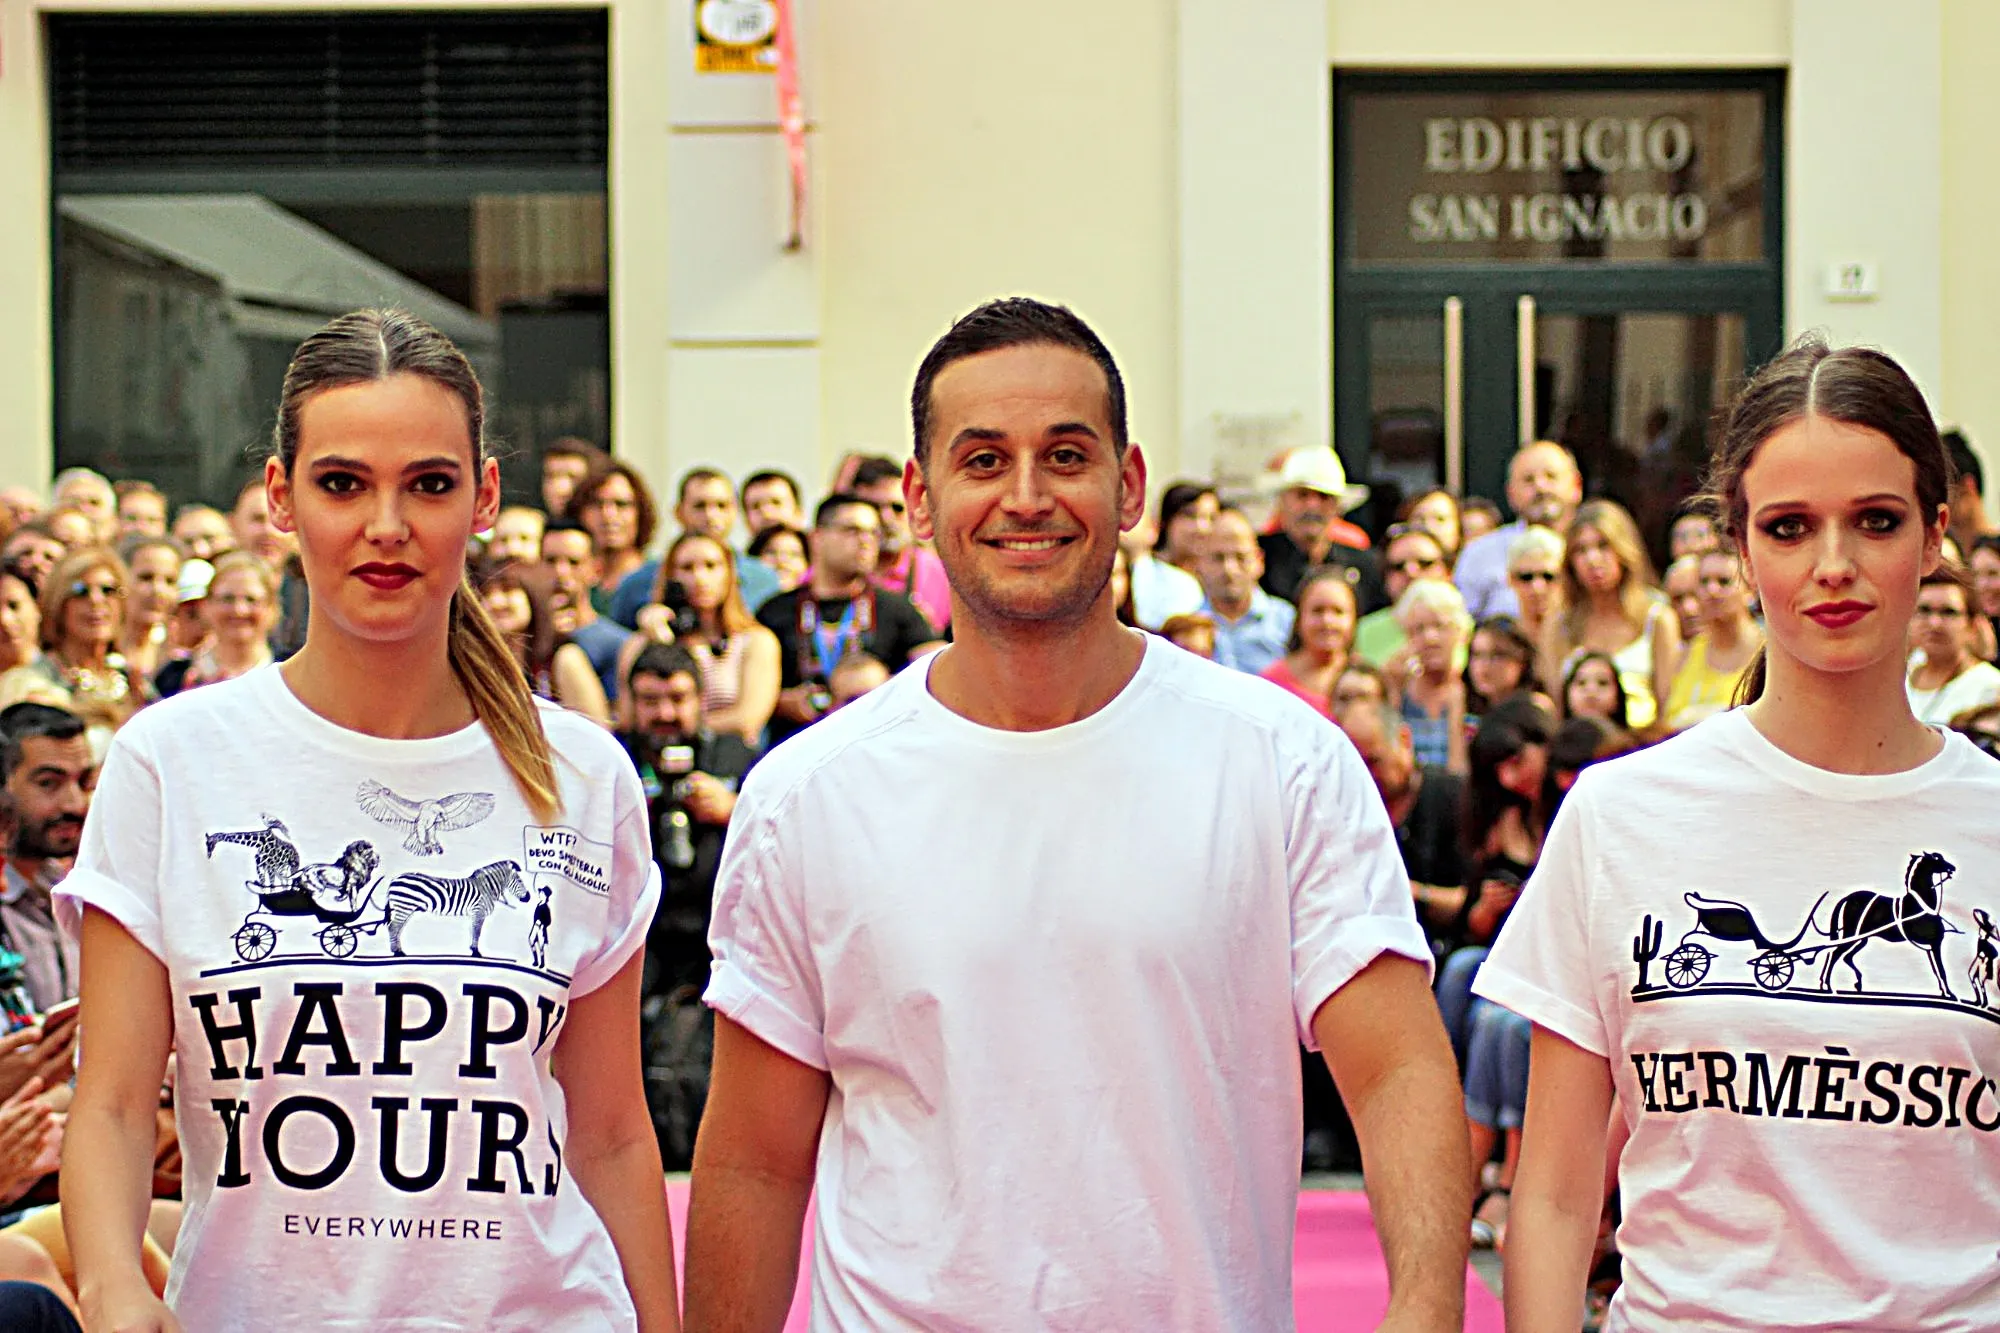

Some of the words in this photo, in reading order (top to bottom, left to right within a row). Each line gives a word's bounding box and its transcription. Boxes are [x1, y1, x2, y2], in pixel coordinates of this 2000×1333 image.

[1423, 116, 1692, 173] EDIFICIO
[1408, 193, 1498, 242] SAN
[1508, 193, 1708, 242] IGNACIO
[540, 832, 578, 848] WTF?
[529, 848, 556, 858] DEVO
[538, 860, 561, 871] CON
[284, 1214, 503, 1240] EVERYWHERE
